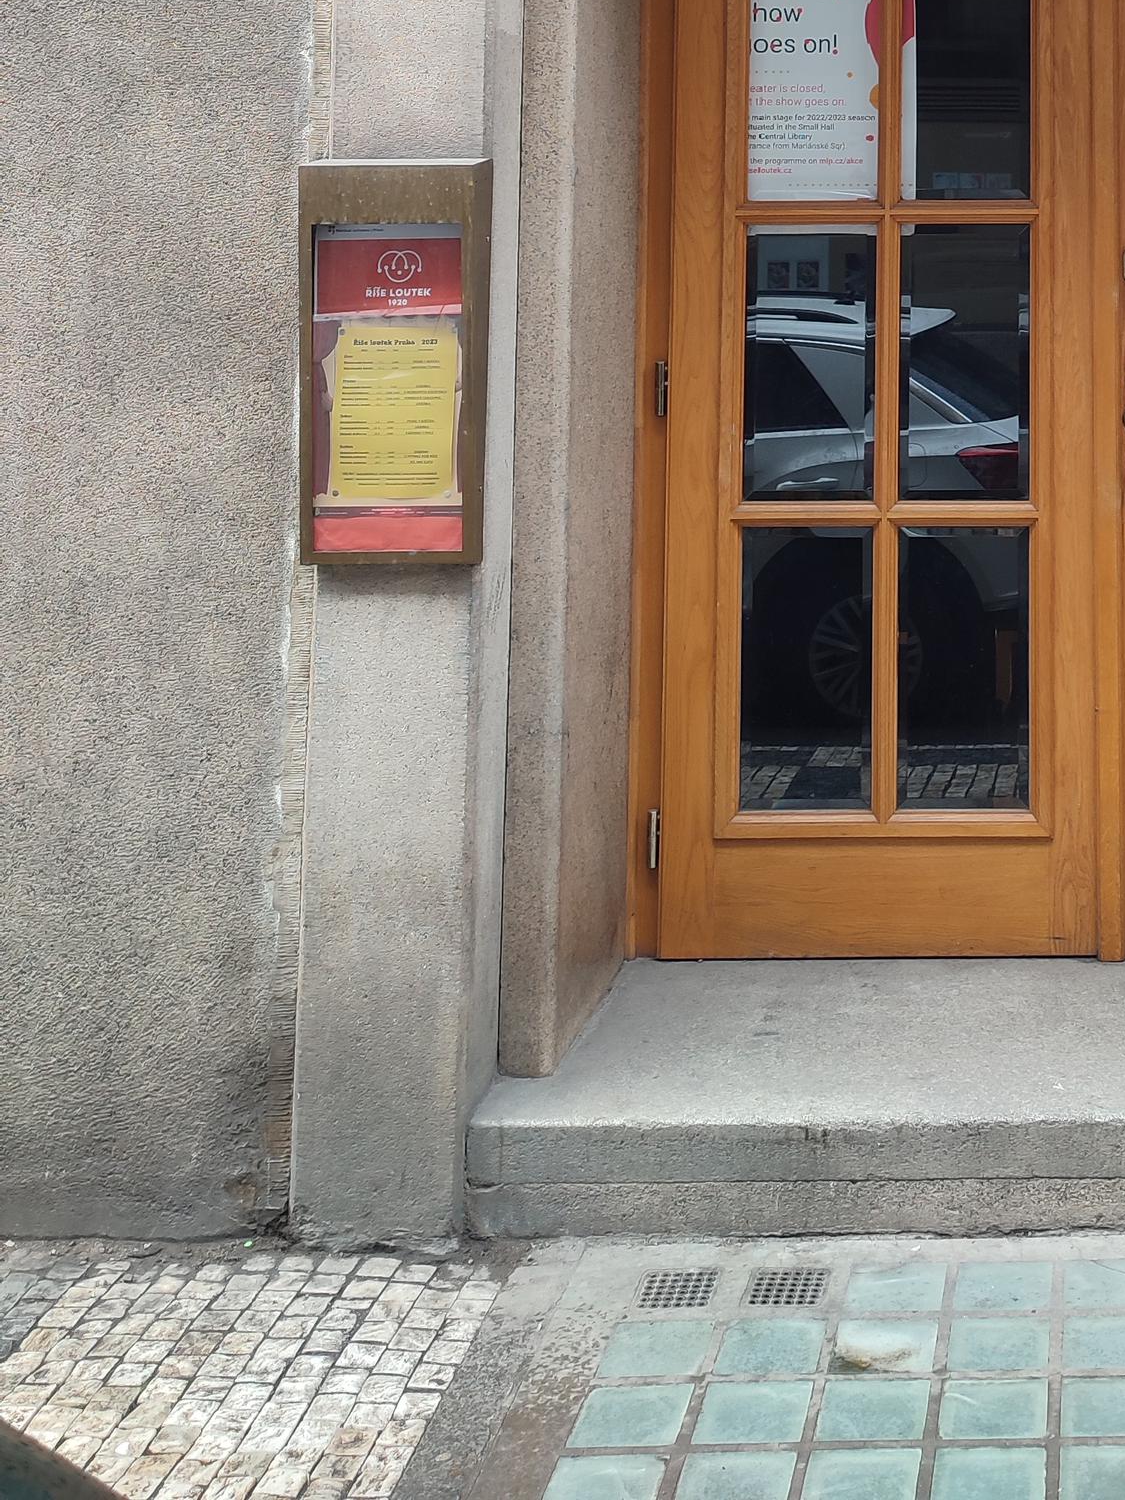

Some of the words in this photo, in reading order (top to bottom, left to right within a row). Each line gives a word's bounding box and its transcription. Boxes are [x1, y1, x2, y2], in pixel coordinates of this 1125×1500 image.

[752, 2, 803, 23] how
[753, 38, 796, 54] oes
[803, 34, 839, 55] on!
[779, 83, 788, 93] is
[775, 97, 802, 106] show
[804, 99, 829, 109] goes
[795, 113, 806, 121] for
[798, 122, 819, 131] Small
[758, 132, 786, 140] Central
[787, 132, 813, 141] Library
[389, 287, 432, 297] LOUTEK
